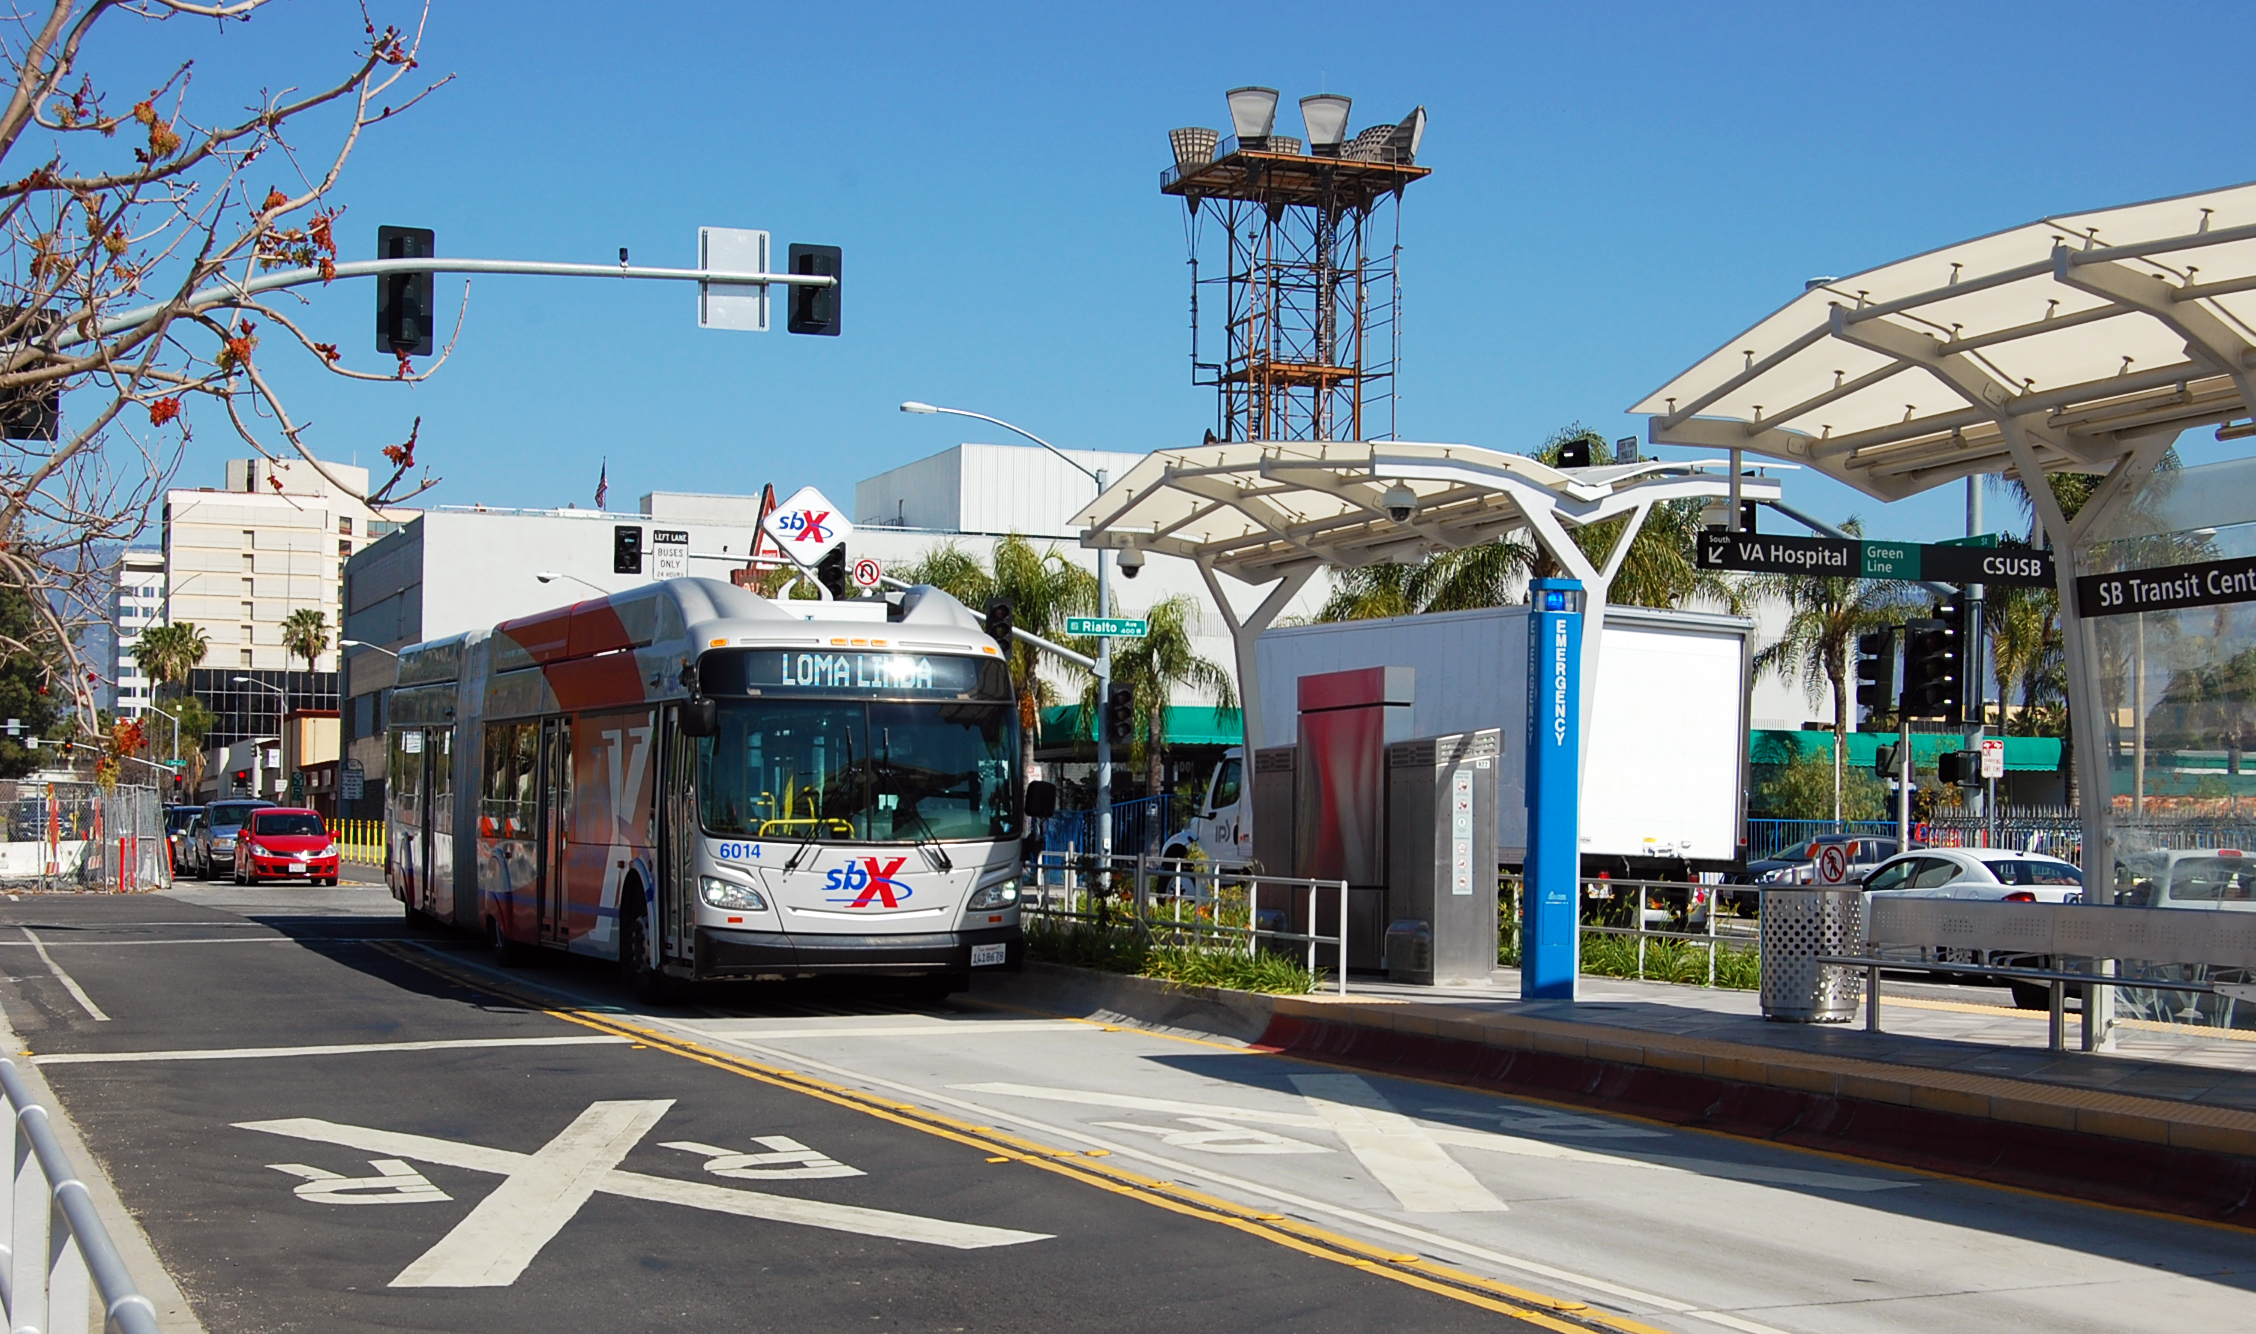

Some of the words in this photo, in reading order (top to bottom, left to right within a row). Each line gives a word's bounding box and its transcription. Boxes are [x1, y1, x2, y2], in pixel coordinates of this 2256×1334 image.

[776, 509, 833, 543] sbX
[655, 533, 669, 541] LEFT
[671, 534, 687, 542] LANE
[1709, 535, 1731, 544] South
[658, 548, 684, 557] BUSES
[1739, 543, 1764, 562] VA
[1770, 545, 1847, 569] Hospital
[1867, 546, 1904, 560] Green
[660, 560, 680, 568] ONLY
[1867, 560, 1893, 573] Line
[1983, 557, 2042, 577] CSUSB
[2099, 581, 2123, 607] SB
[2129, 573, 2201, 604] Transit
[1082, 621, 1118, 633] Rialto
[782, 653, 850, 686] LOMA
[1526, 620, 1536, 745] EMERGENCY
[1554, 619, 1567, 746] EMERGENCY
[720, 843, 761, 858] 6014
[822, 857, 912, 908] sbX
